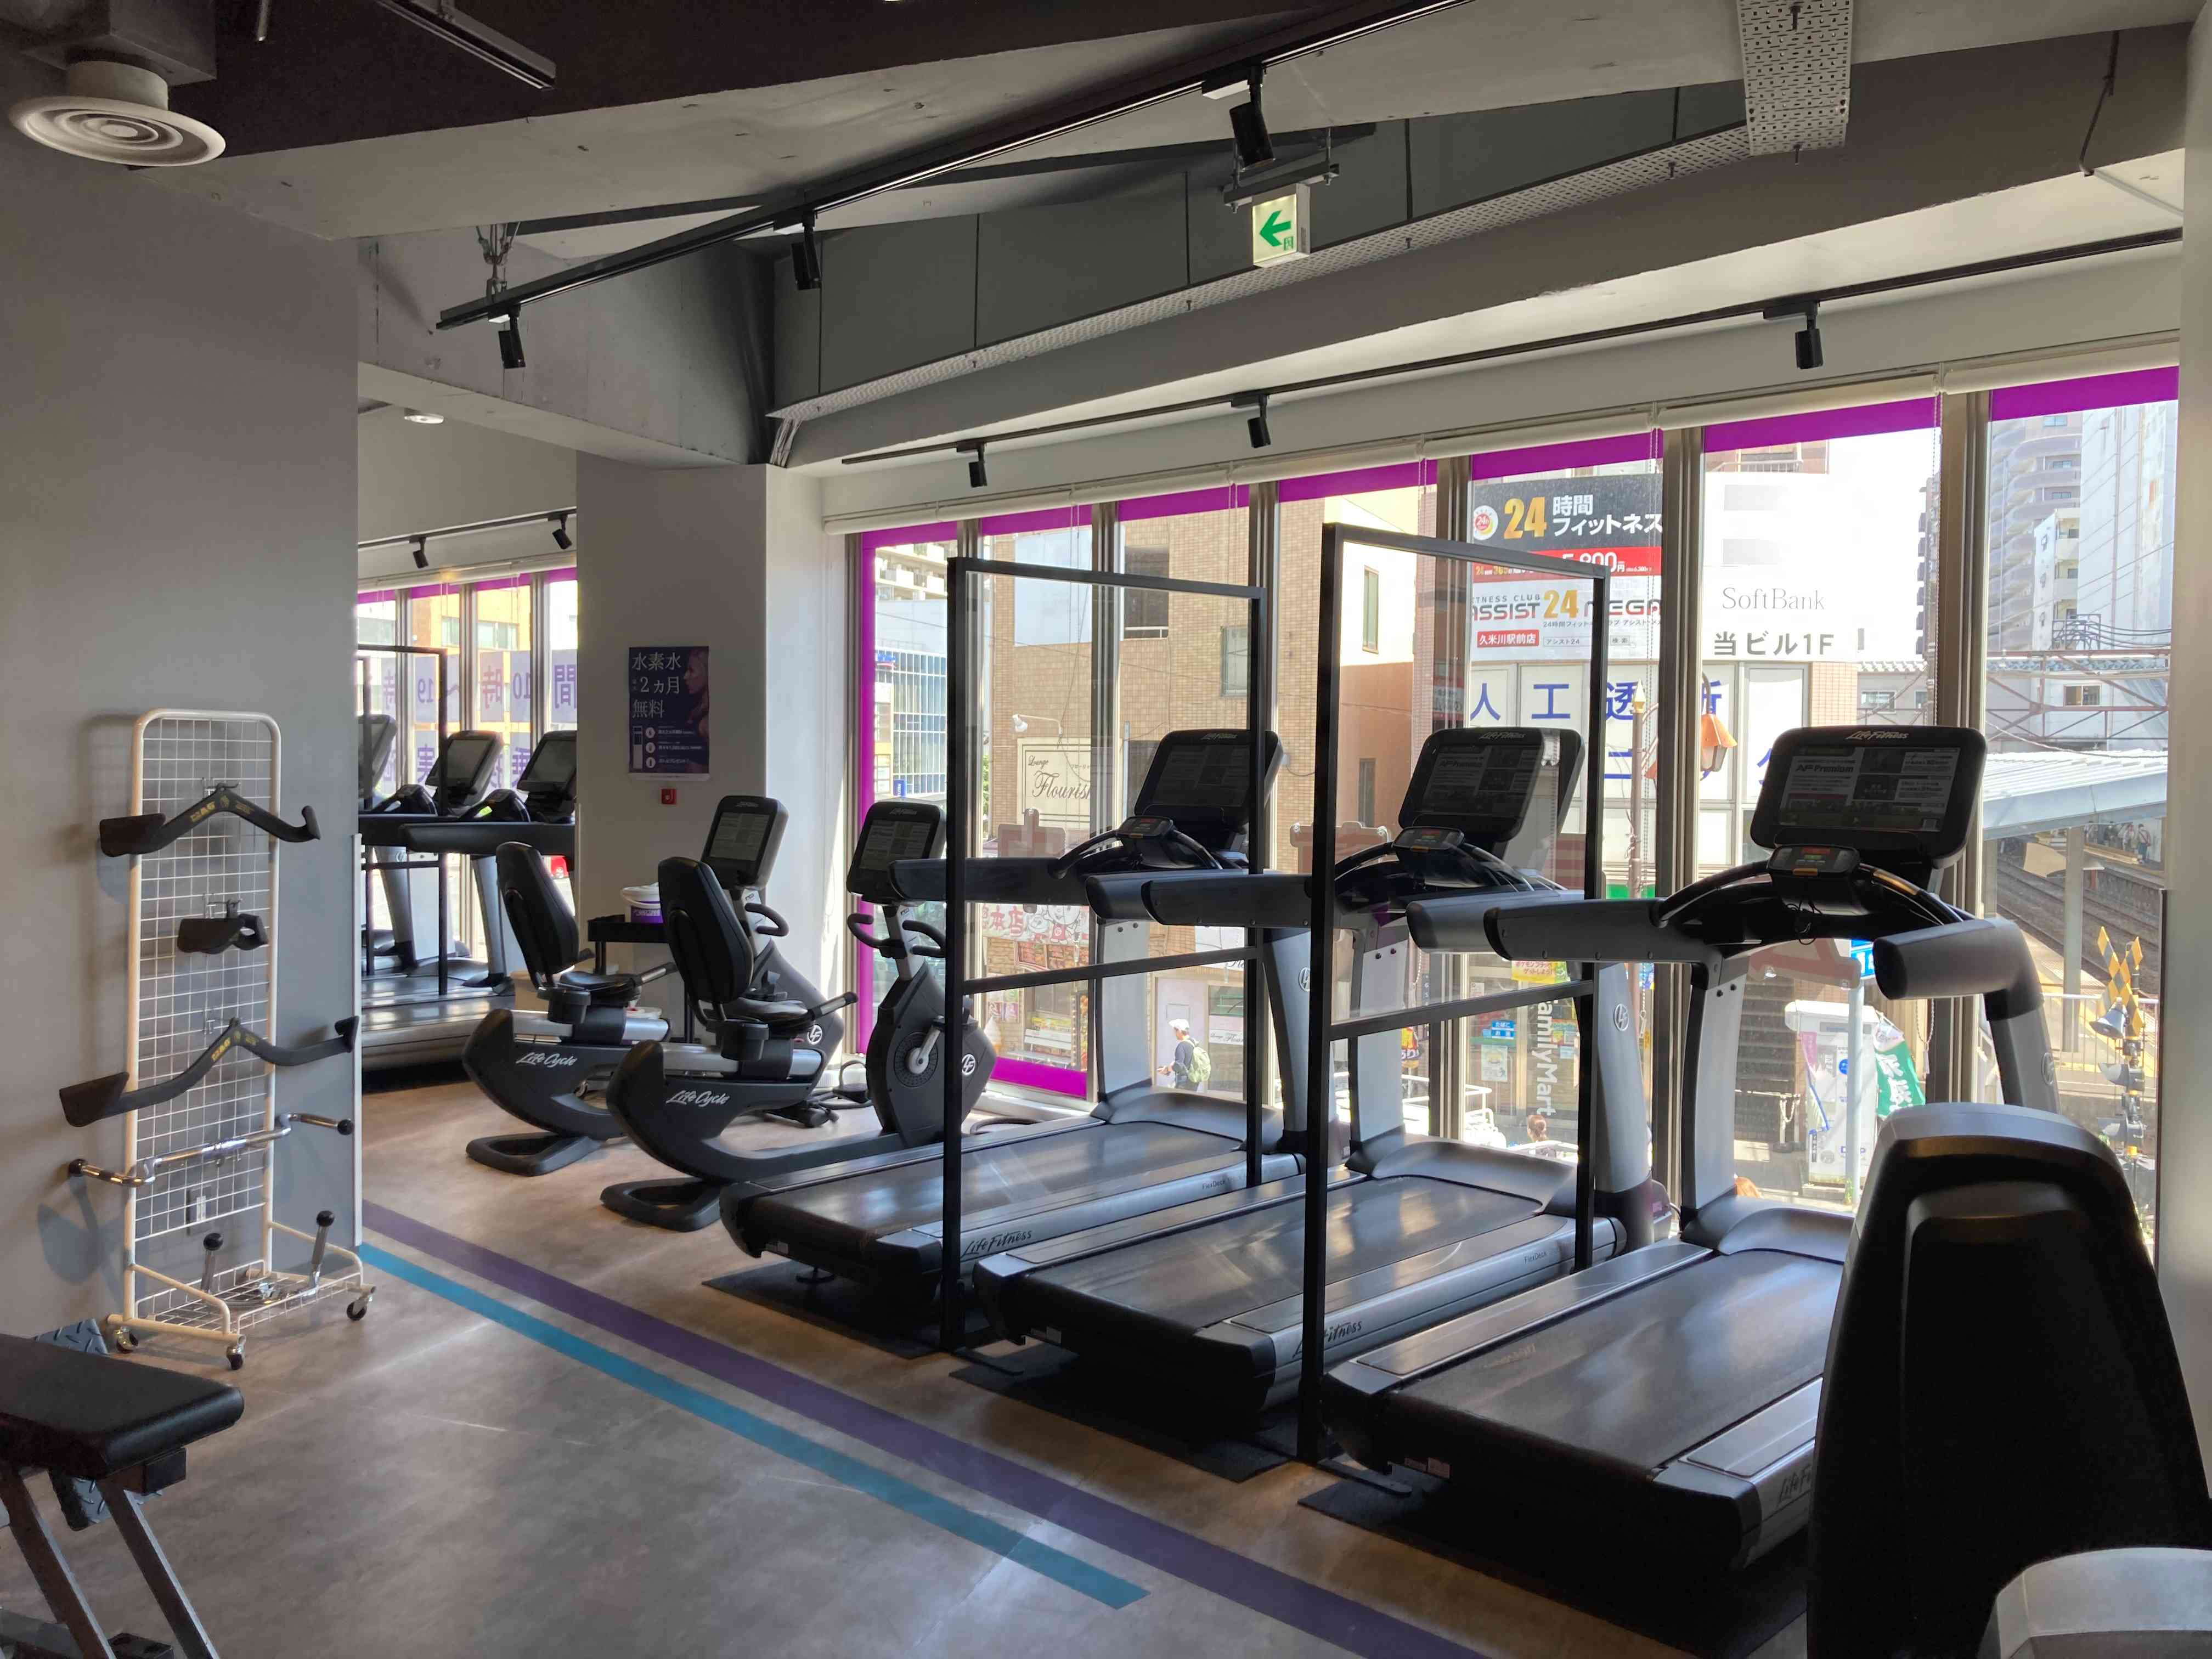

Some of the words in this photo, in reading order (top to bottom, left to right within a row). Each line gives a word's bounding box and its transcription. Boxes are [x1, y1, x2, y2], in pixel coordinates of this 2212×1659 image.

[1504, 496, 1547, 539] 24
[1553, 495, 1593, 516] 時間
[1553, 514, 1663, 537] フィットネス
[1544, 590, 1579, 619] 24
[1723, 587, 1825, 610] SoftBank
[1480, 634, 1536, 646] 久米川駅前店
[1714, 630, 1835, 656] 当ビル1F
[632, 652, 681, 670] 水素水
[633, 699, 665, 718] 無料
[1531, 1000, 1559, 1116] amilyMart
